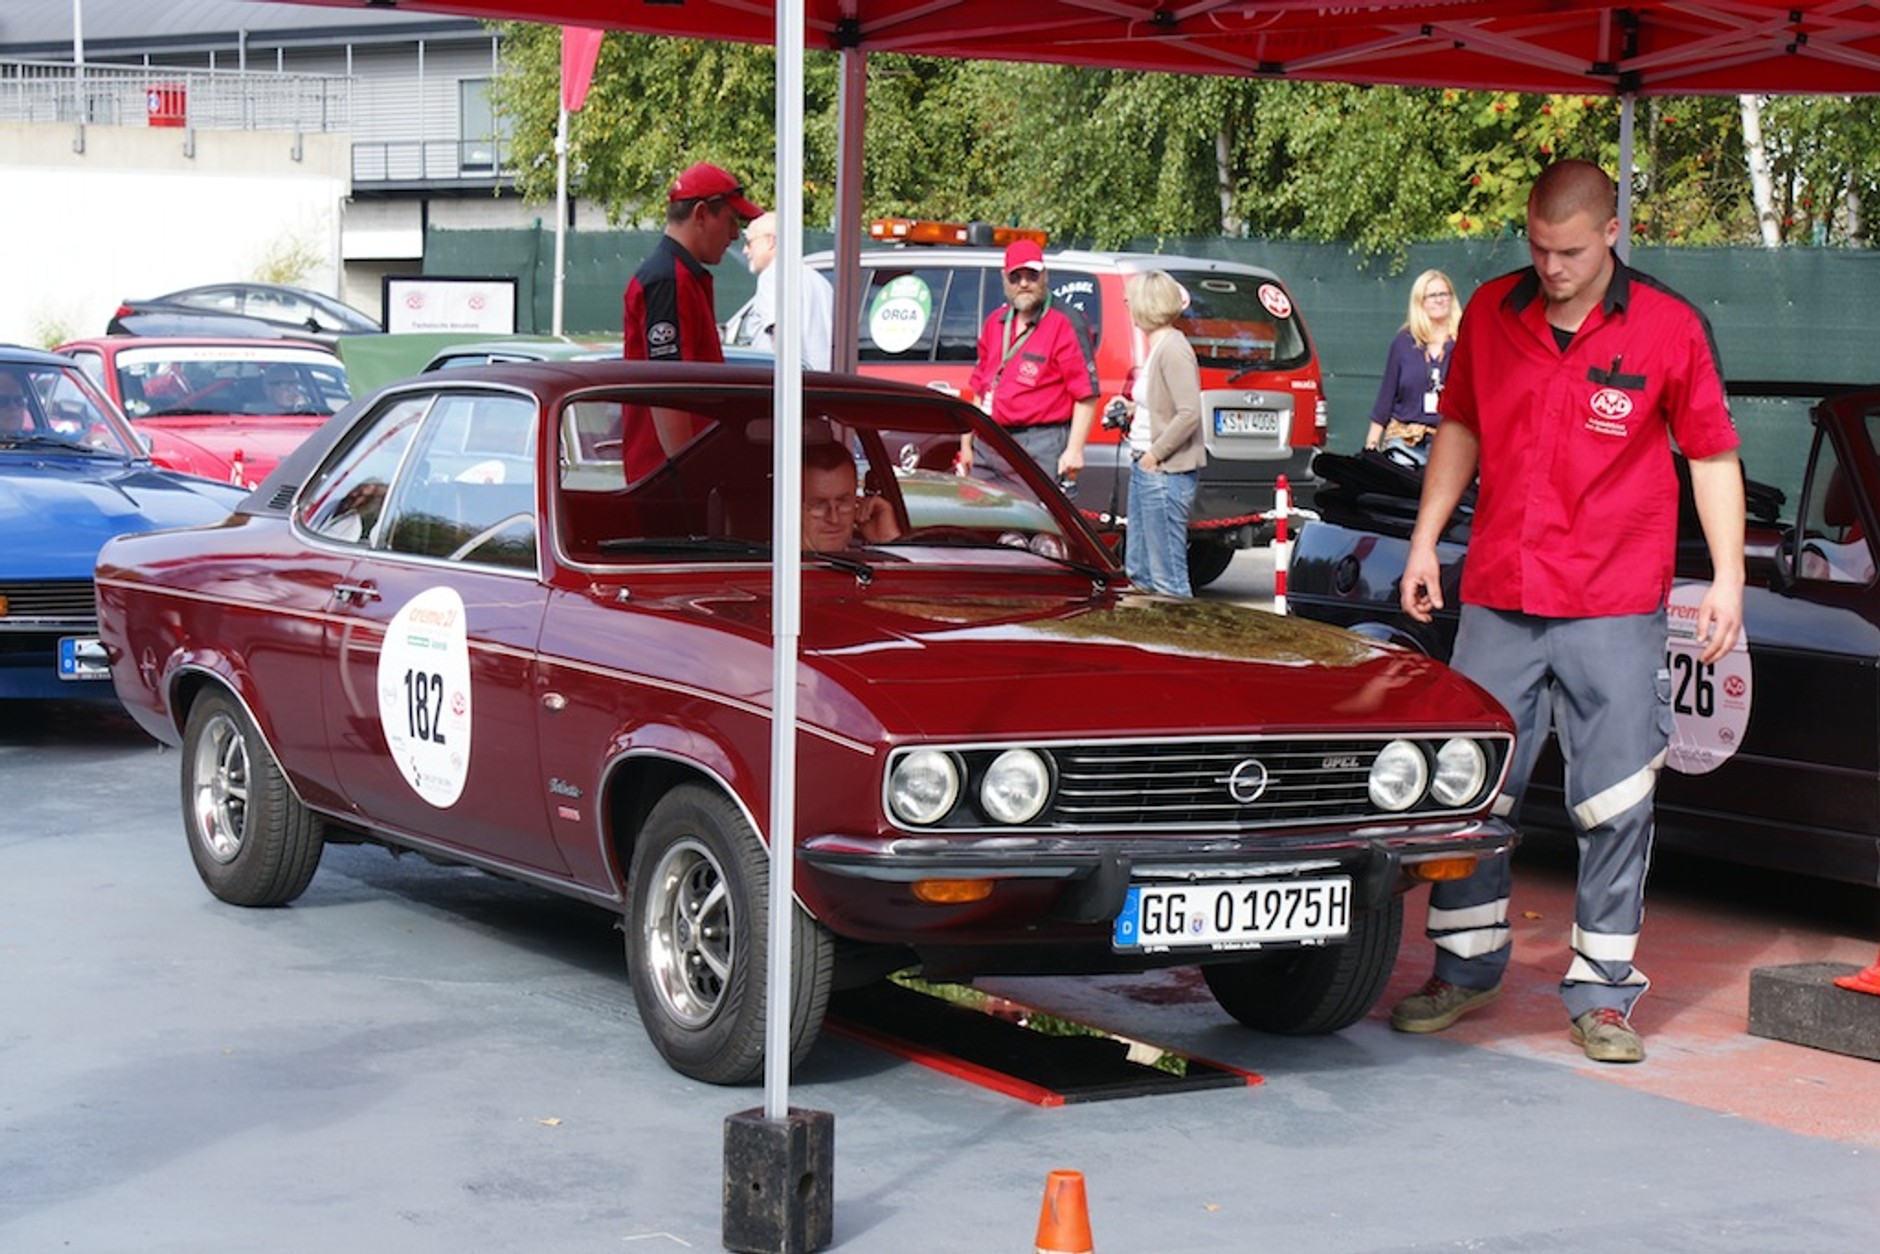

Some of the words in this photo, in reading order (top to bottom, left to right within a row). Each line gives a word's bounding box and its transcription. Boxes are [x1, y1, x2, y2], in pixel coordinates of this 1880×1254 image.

[881, 308, 917, 320] ORGA
[404, 668, 446, 745] 182
[1321, 756, 1360, 769] OPEL
[1142, 893, 1186, 935] GG
[1121, 921, 1132, 935] D
